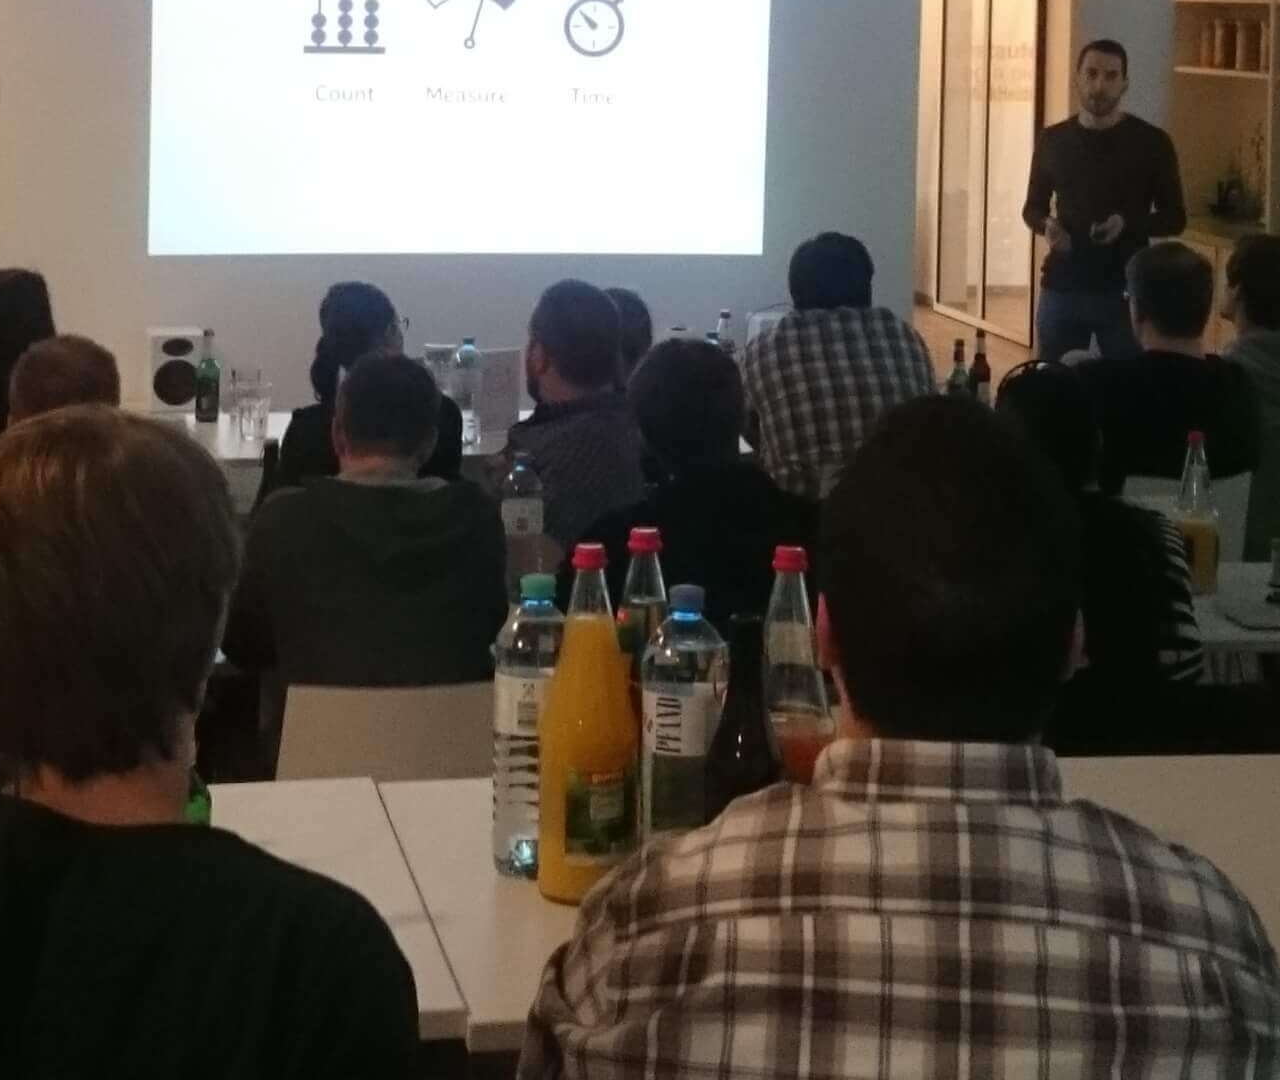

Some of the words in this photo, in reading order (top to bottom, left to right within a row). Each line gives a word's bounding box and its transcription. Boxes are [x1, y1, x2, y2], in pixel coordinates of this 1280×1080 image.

[315, 85, 374, 103] Count
[425, 86, 509, 104] Measure
[568, 87, 616, 105] Time
